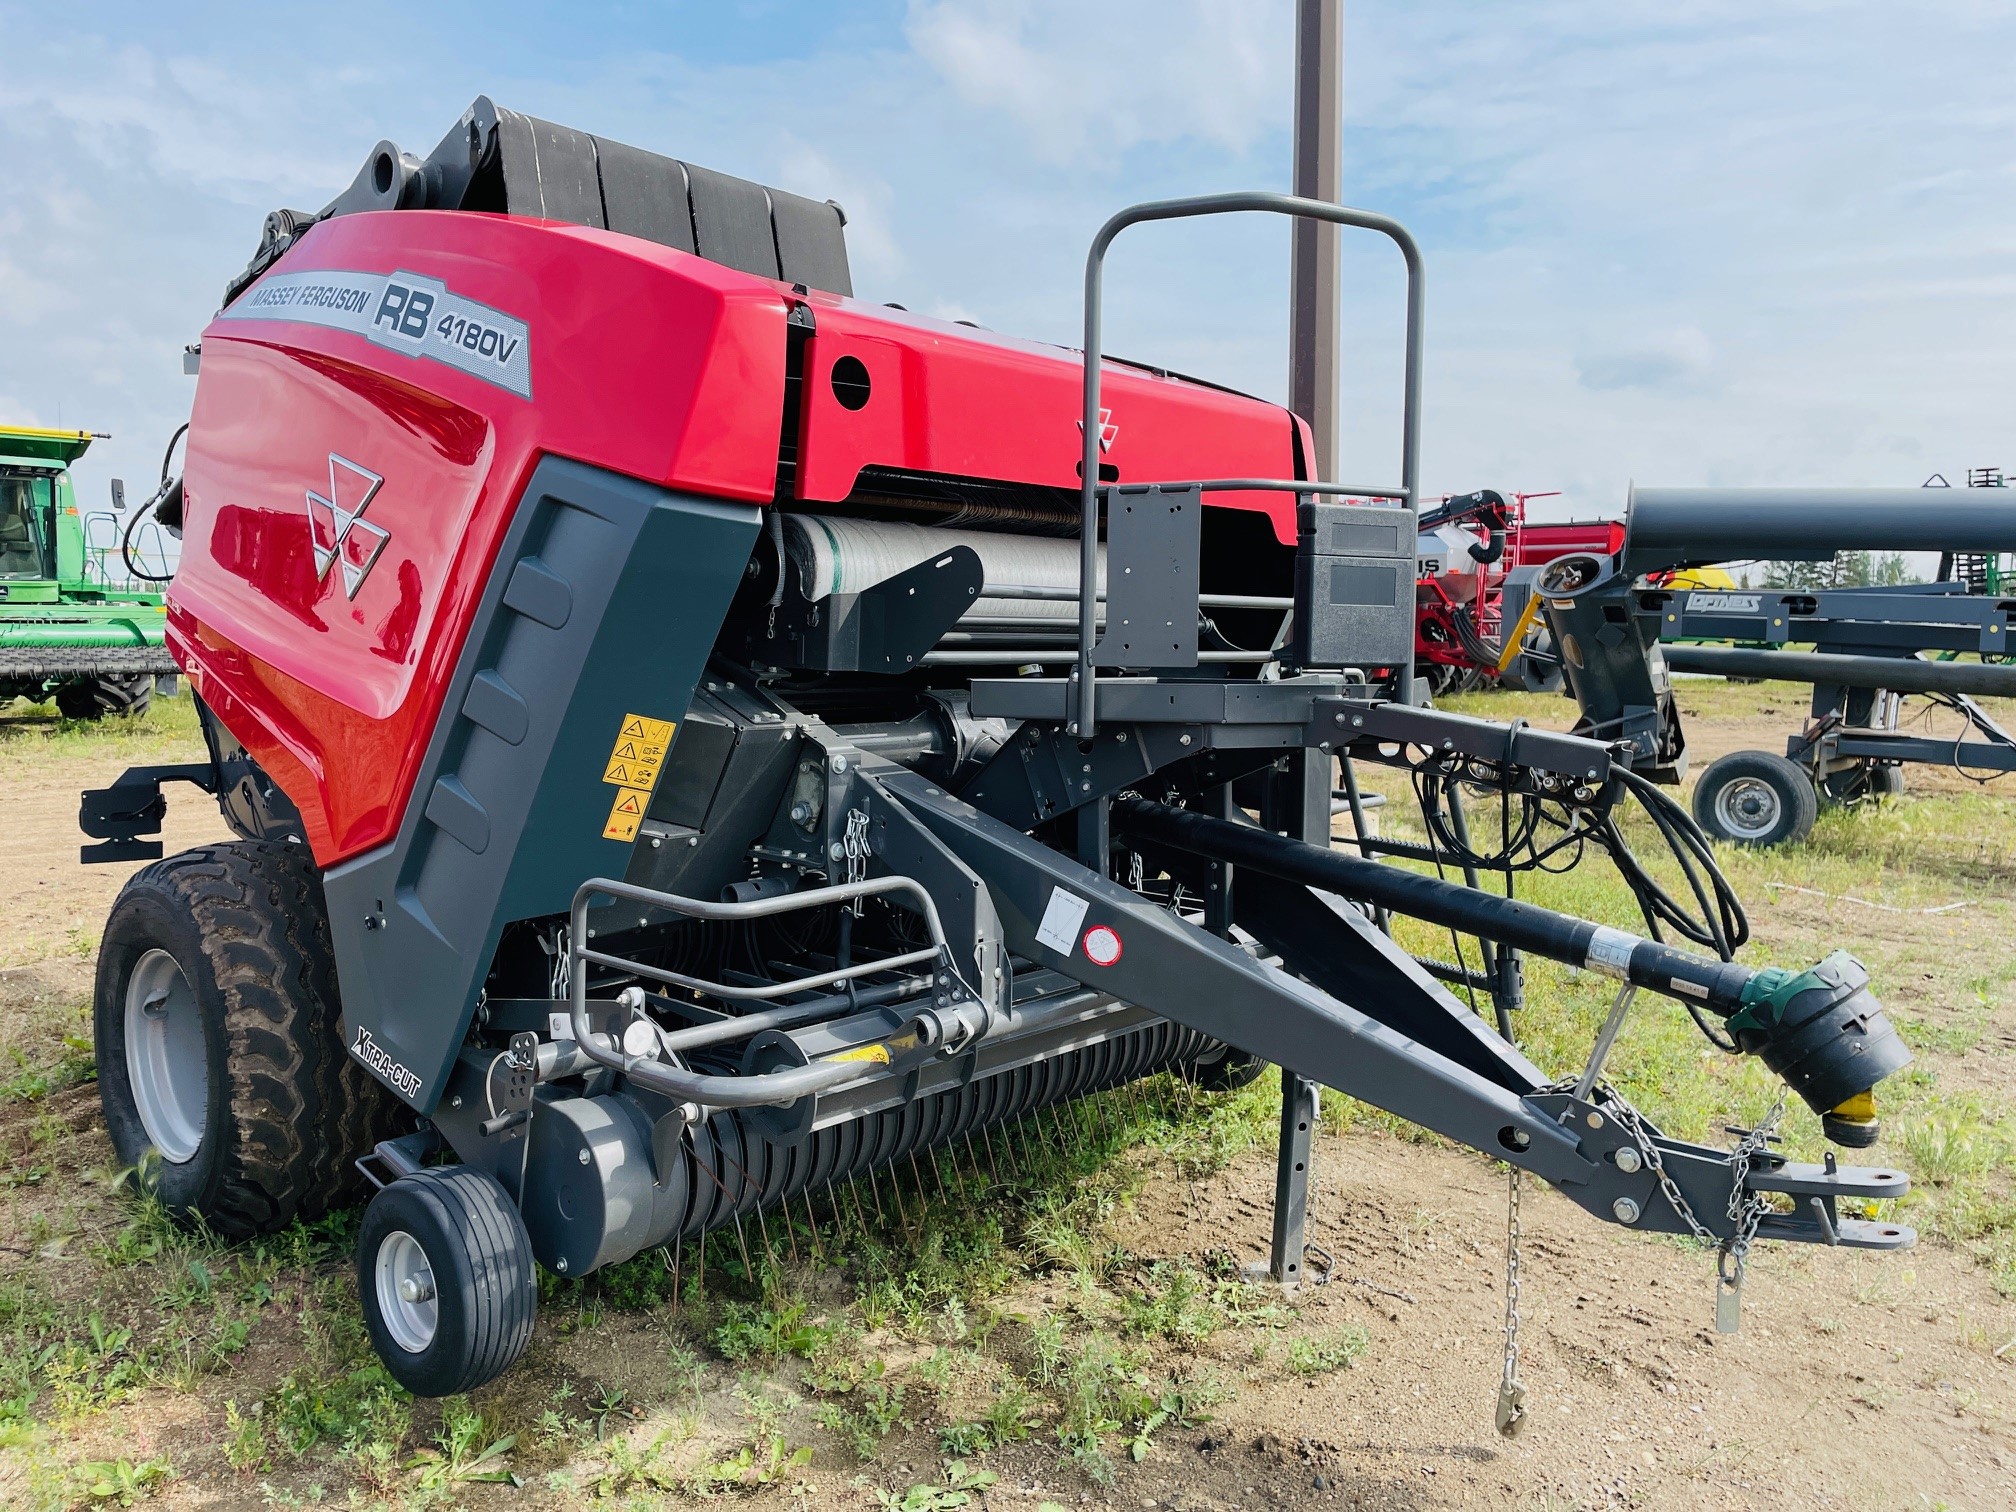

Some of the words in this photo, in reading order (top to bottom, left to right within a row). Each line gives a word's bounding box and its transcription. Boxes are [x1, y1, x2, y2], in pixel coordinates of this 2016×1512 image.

[250, 286, 301, 307] MASSEY
[297, 286, 372, 313] FERGUSON
[374, 284, 435, 339] RB
[437, 315, 518, 363] 4180V
[1686, 592, 1762, 613] LOFTNESS
